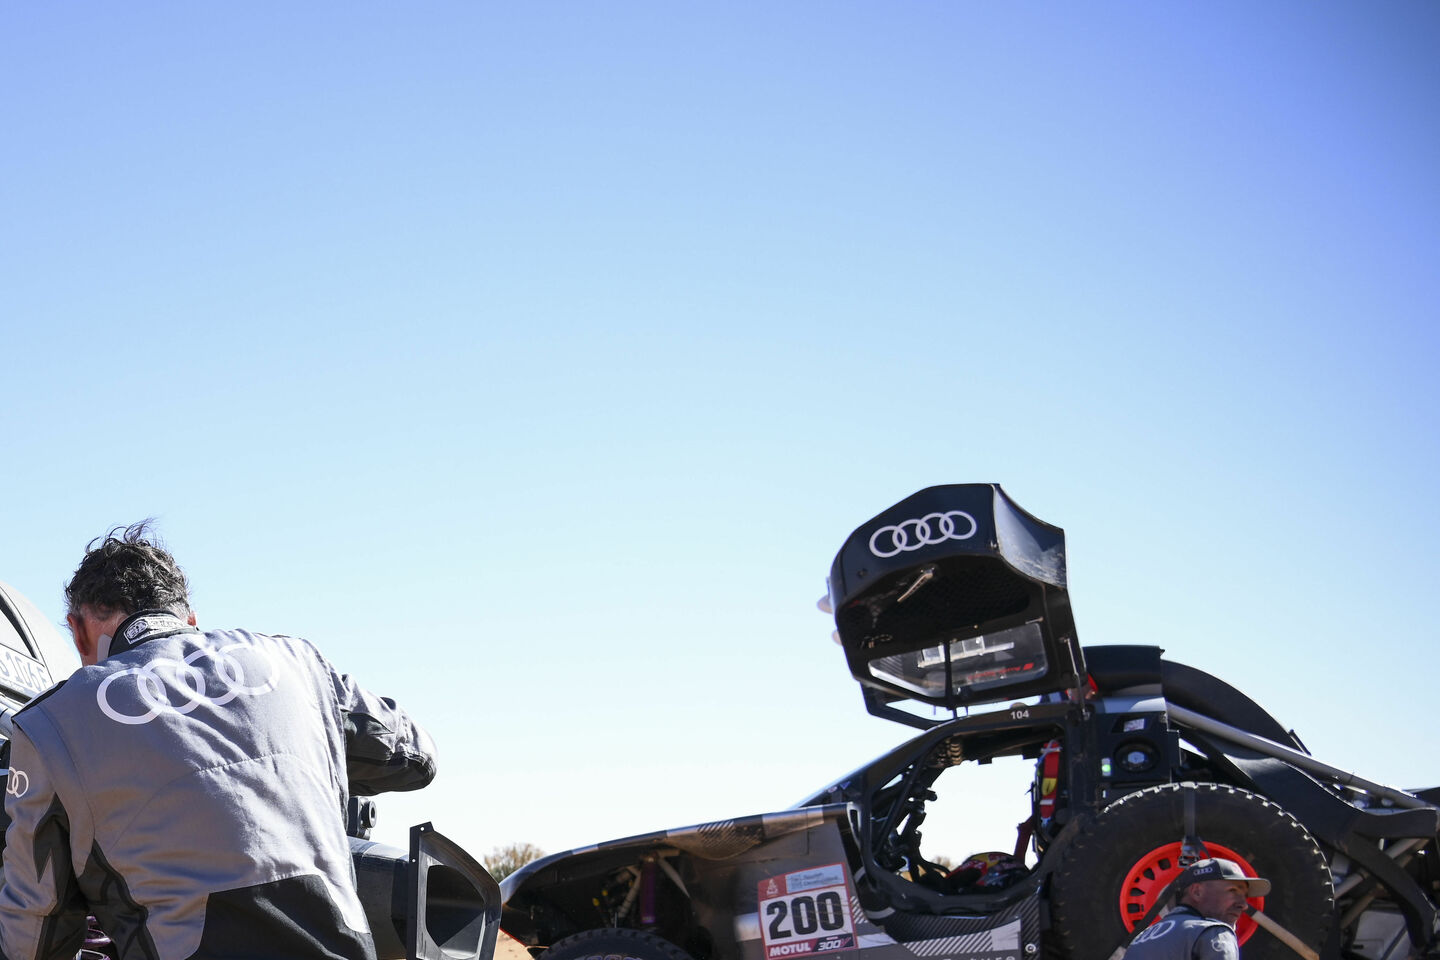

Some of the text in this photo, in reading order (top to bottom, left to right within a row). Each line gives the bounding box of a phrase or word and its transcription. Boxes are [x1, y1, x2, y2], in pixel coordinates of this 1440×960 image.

[1010, 710, 1030, 720] 104
[766, 891, 845, 940] 200
[769, 941, 812, 957] MOTUL
